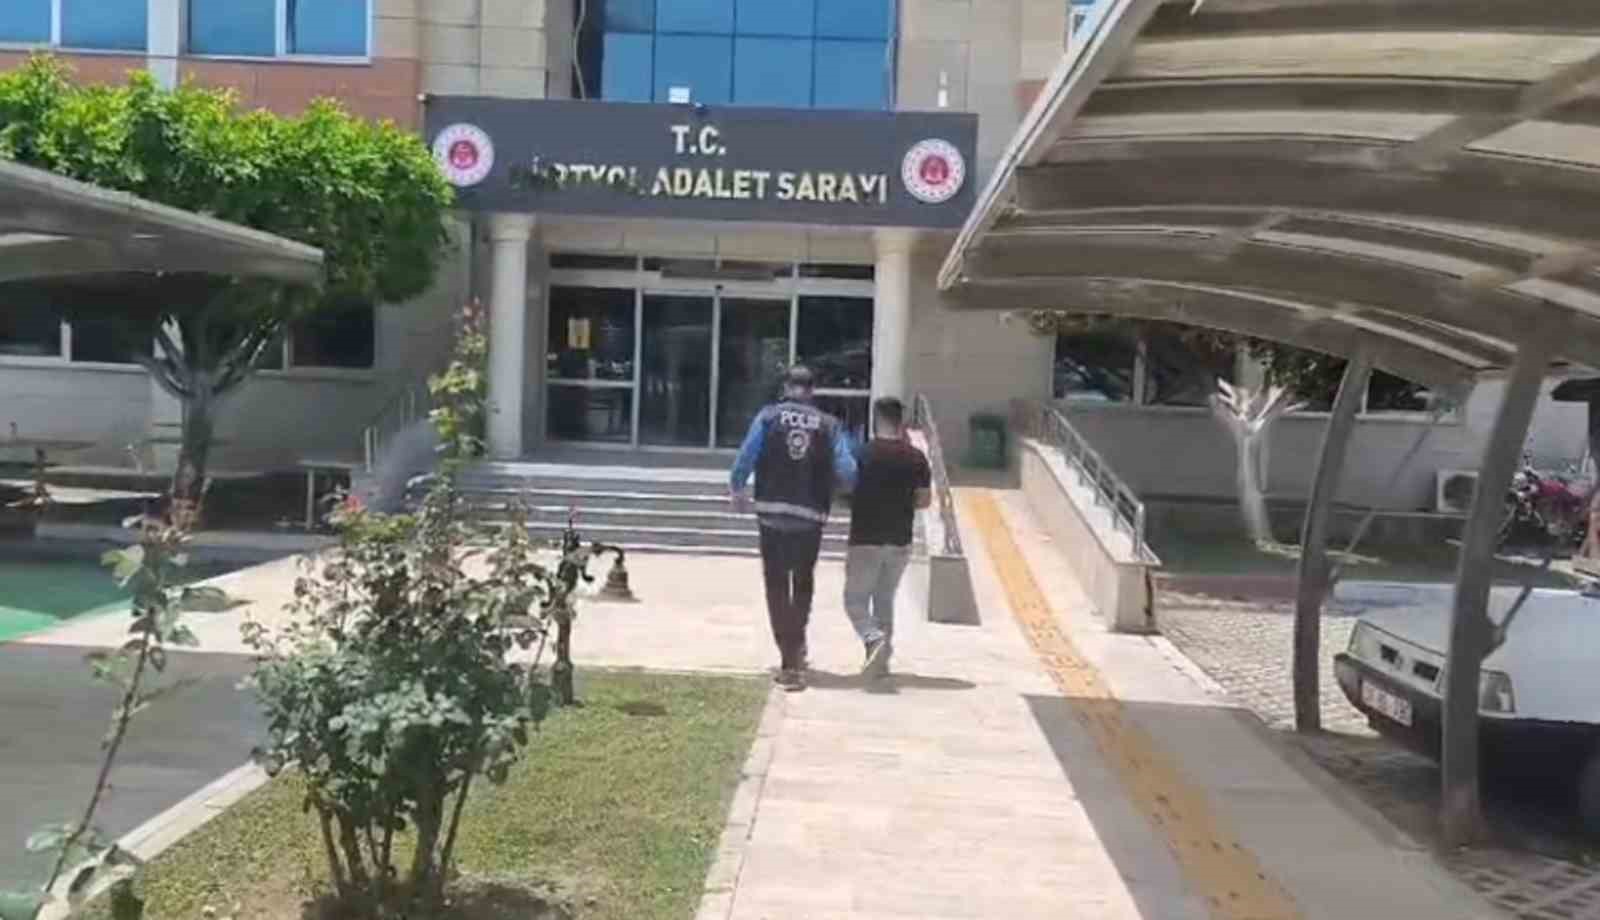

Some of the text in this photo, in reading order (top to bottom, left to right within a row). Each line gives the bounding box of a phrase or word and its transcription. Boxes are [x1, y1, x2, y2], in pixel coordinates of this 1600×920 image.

[671, 125, 727, 154] T.C.
[652, 168, 770, 199] ADALET
[776, 172, 888, 203] SARAYI
